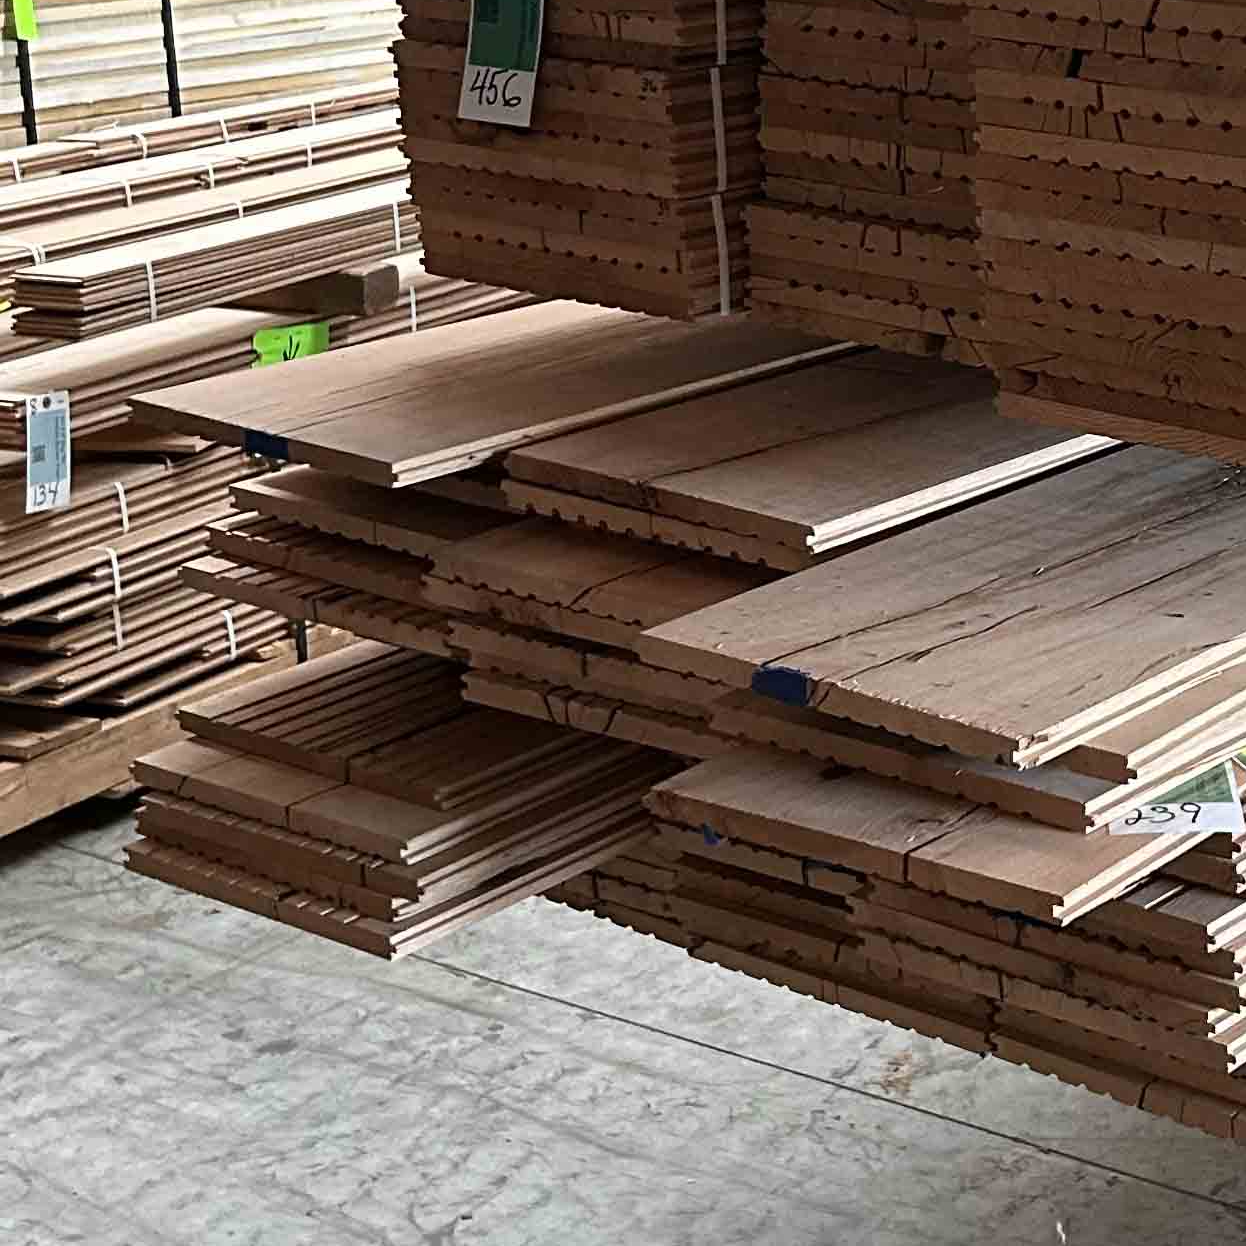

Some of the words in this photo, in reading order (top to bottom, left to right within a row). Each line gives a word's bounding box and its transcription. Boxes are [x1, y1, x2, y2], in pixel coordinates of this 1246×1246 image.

[469, 67, 522, 108] 456
[33, 482, 60, 507] 134
[1124, 801, 1202, 827] 239
